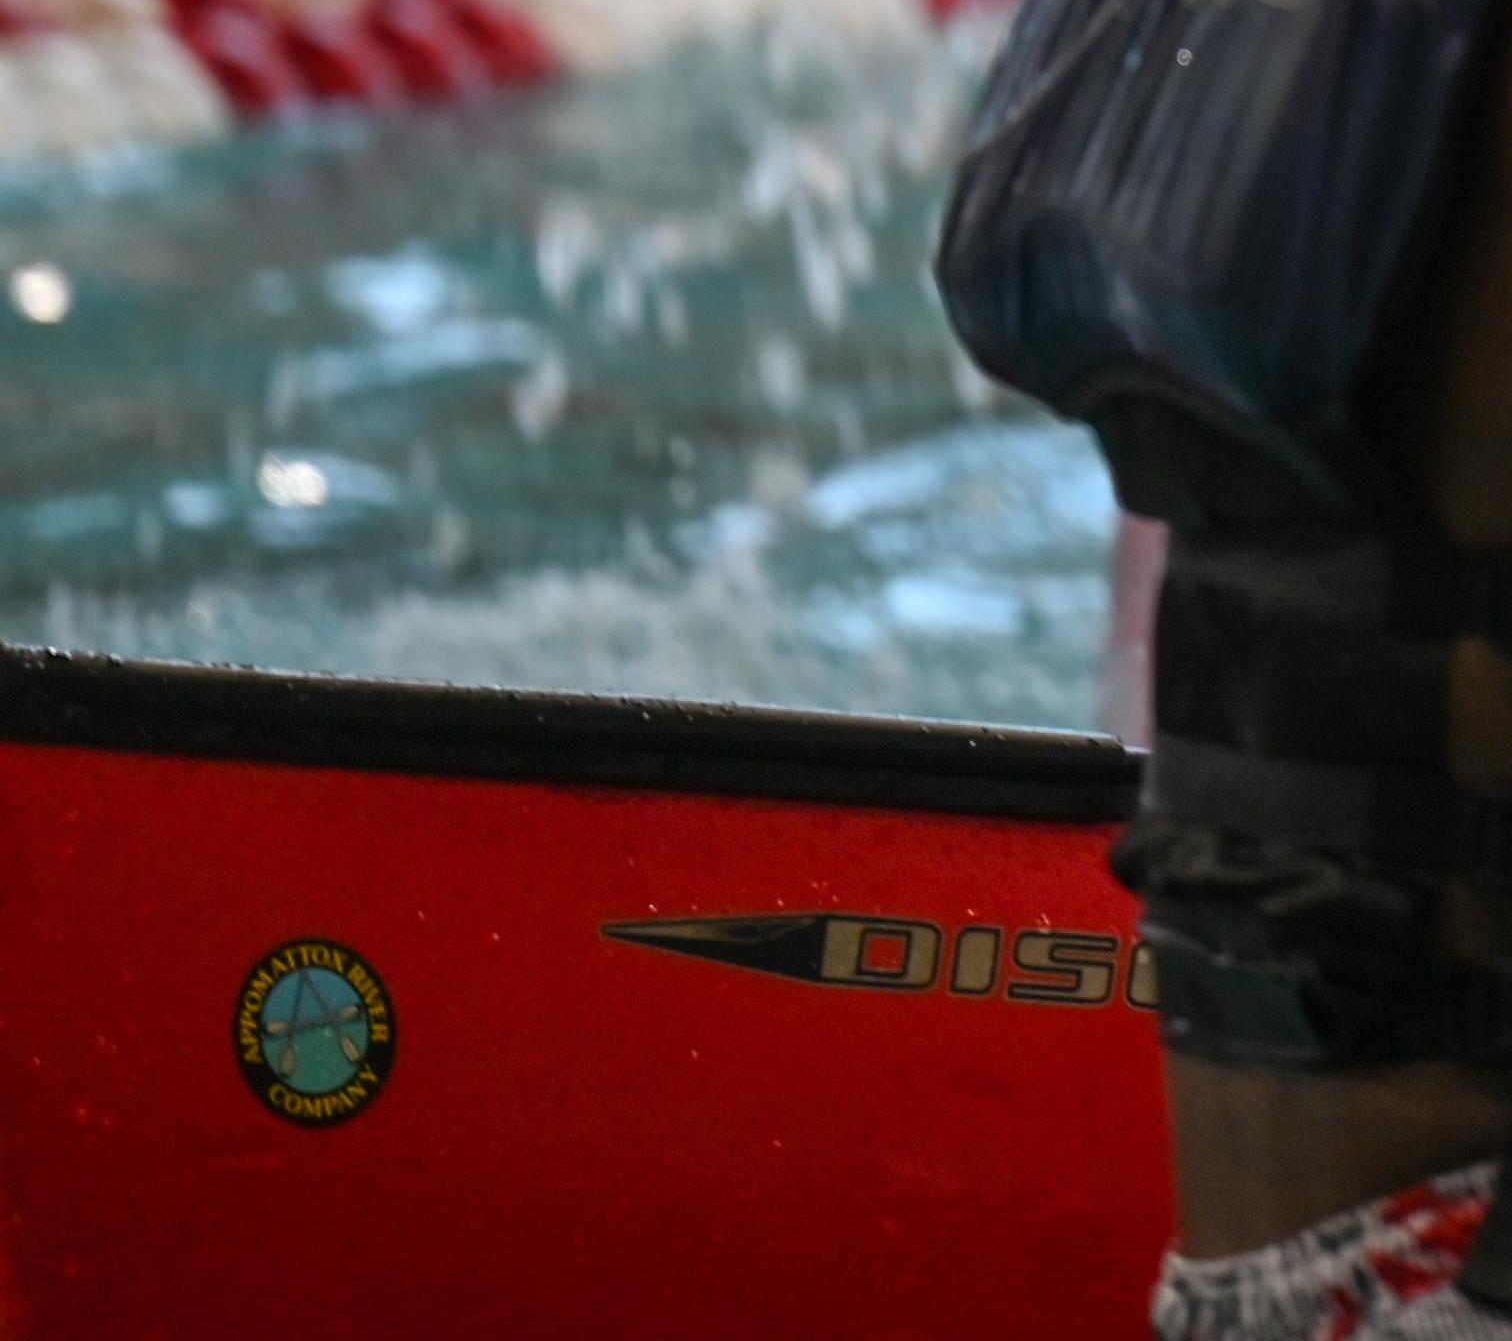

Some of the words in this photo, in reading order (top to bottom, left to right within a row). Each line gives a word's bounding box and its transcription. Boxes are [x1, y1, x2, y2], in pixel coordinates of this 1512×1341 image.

[241, 946, 346, 1063] APPOMATTOX
[349, 964, 390, 1042] RIVER
[270, 1064, 378, 1117] COMPANY
